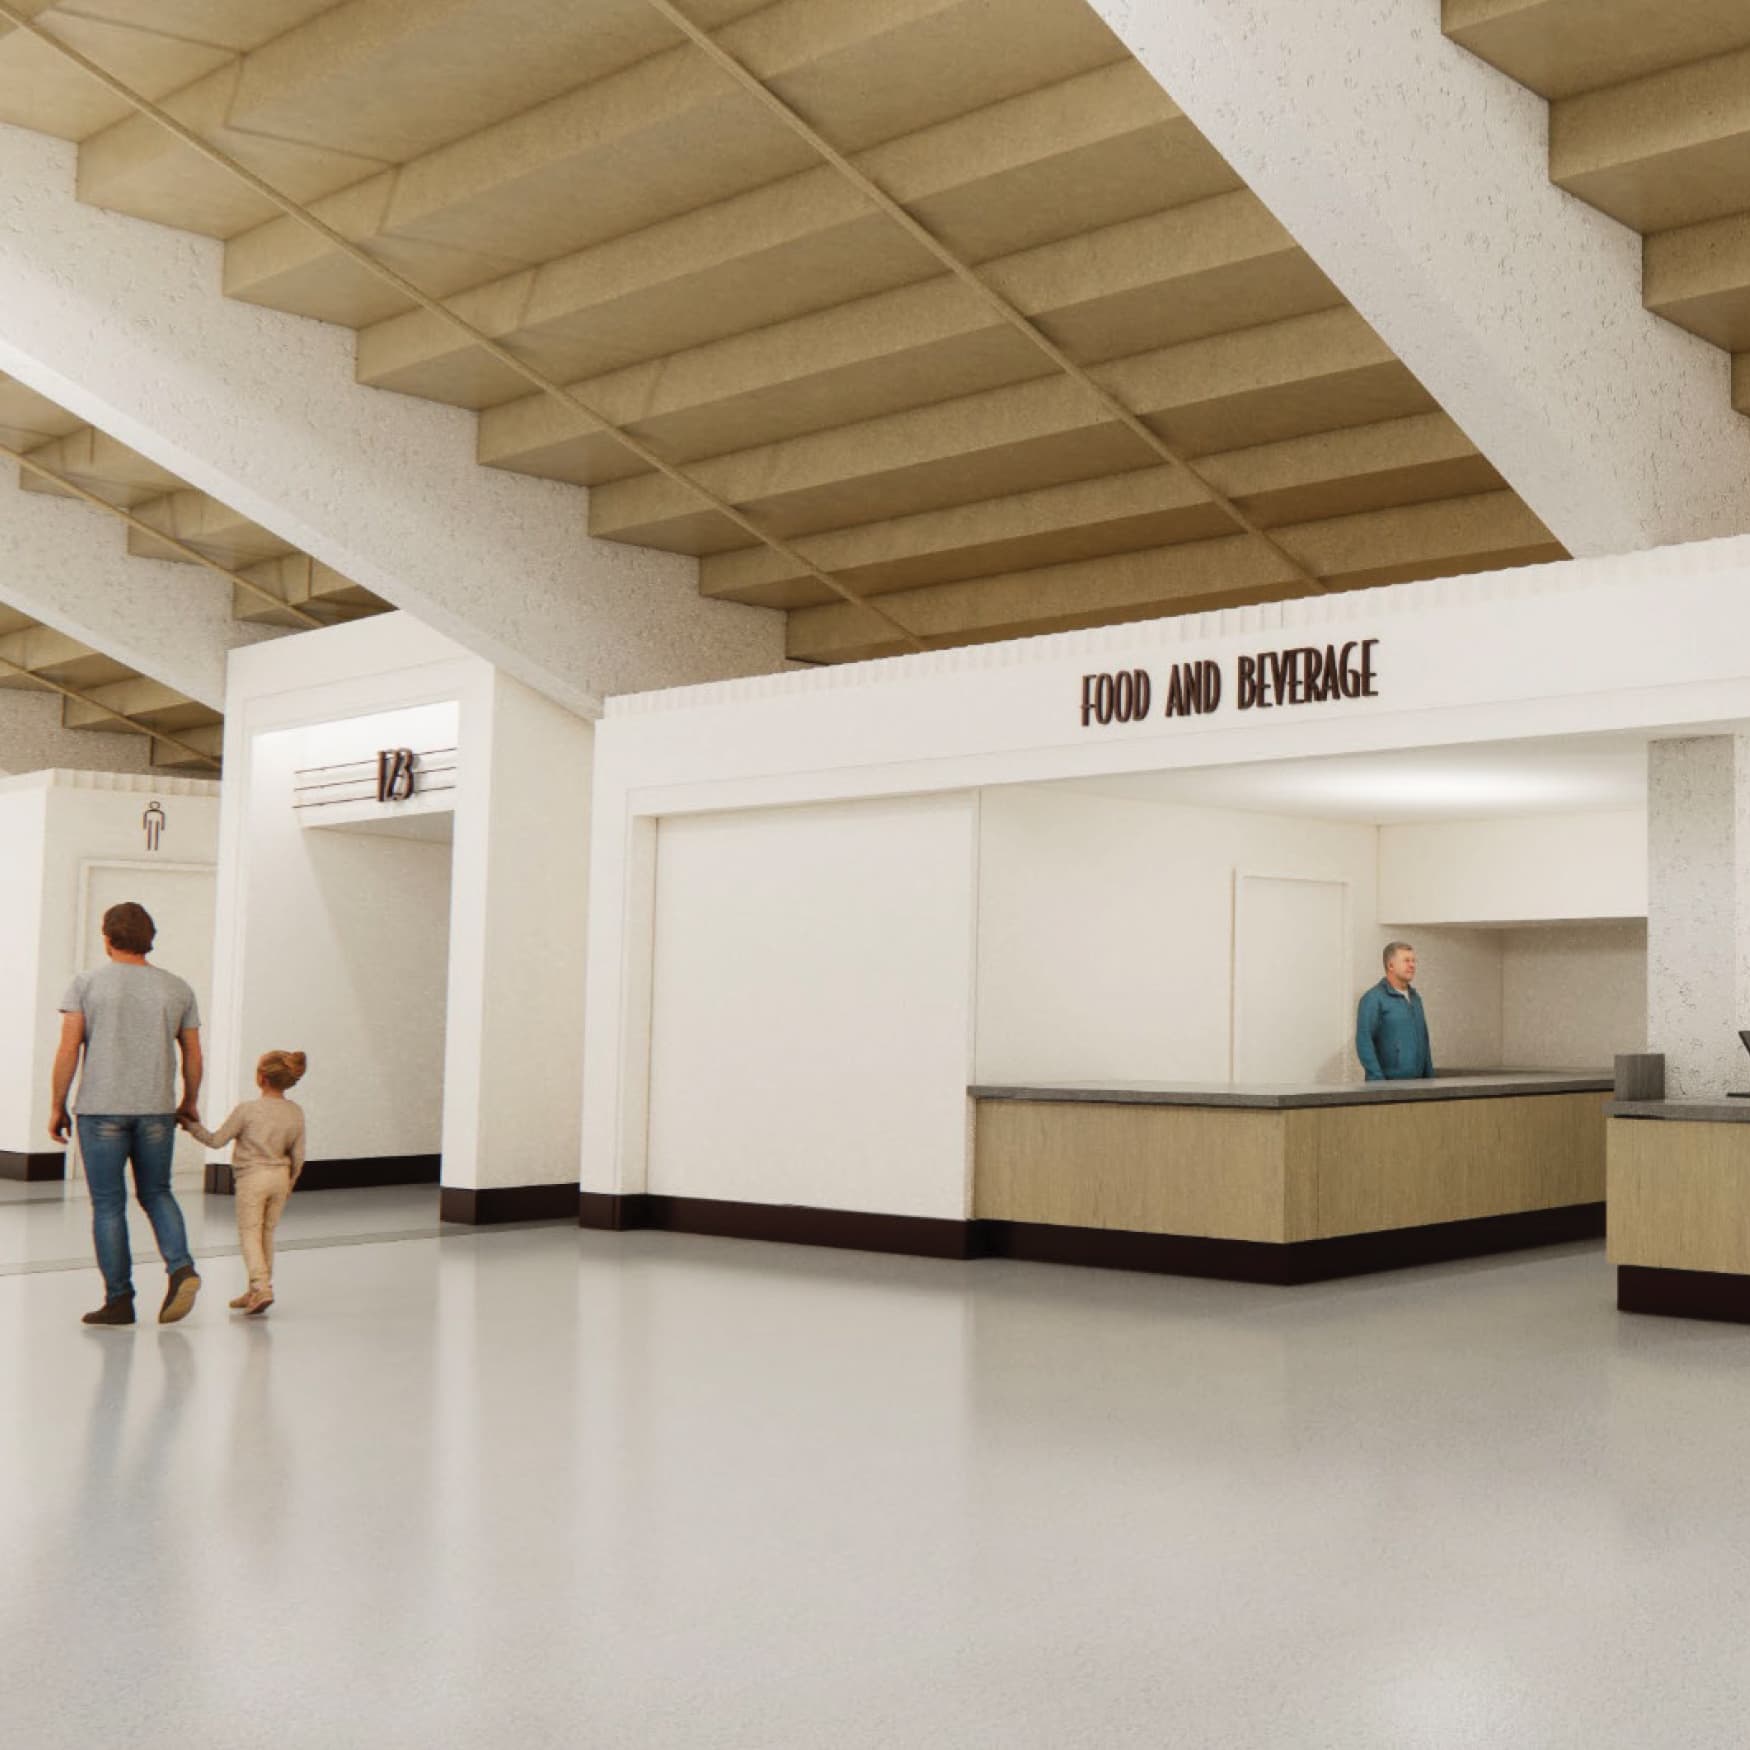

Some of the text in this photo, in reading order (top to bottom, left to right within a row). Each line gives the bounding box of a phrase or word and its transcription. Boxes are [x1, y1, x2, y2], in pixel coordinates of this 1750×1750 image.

[1081, 639, 1379, 726] FOOD AND BEVERAGE
